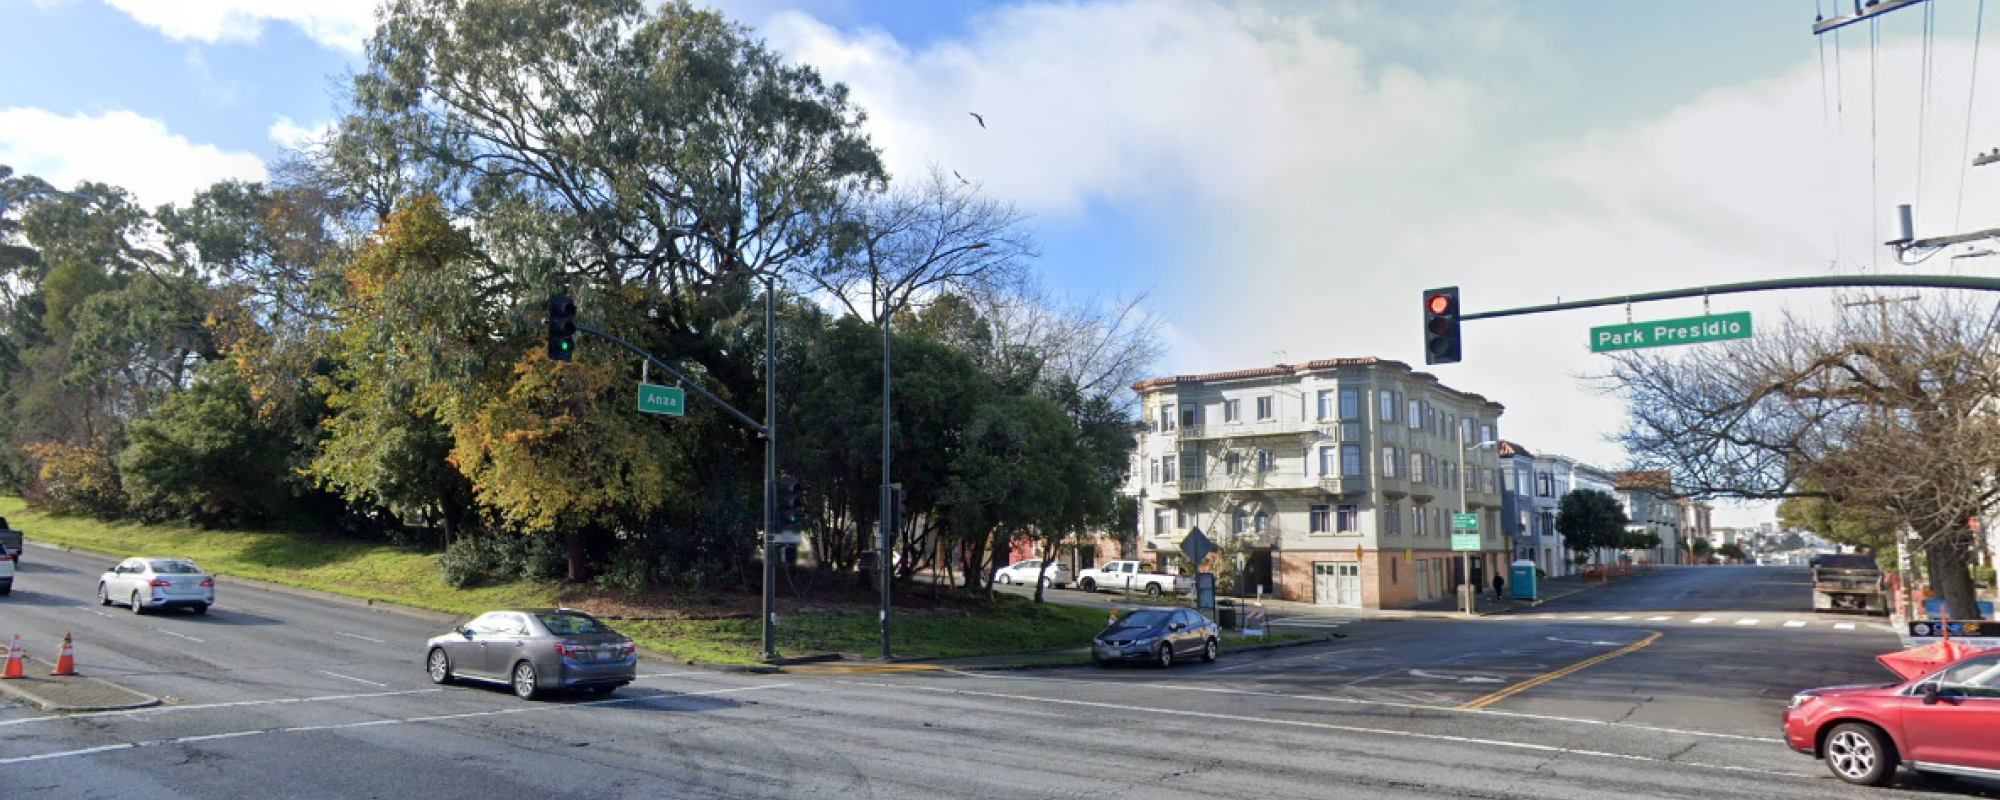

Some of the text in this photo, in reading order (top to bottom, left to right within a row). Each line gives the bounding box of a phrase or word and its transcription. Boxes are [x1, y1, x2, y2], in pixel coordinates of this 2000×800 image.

[1599, 320, 1741, 346] Park Presidio
[647, 393, 677, 407] Anza
